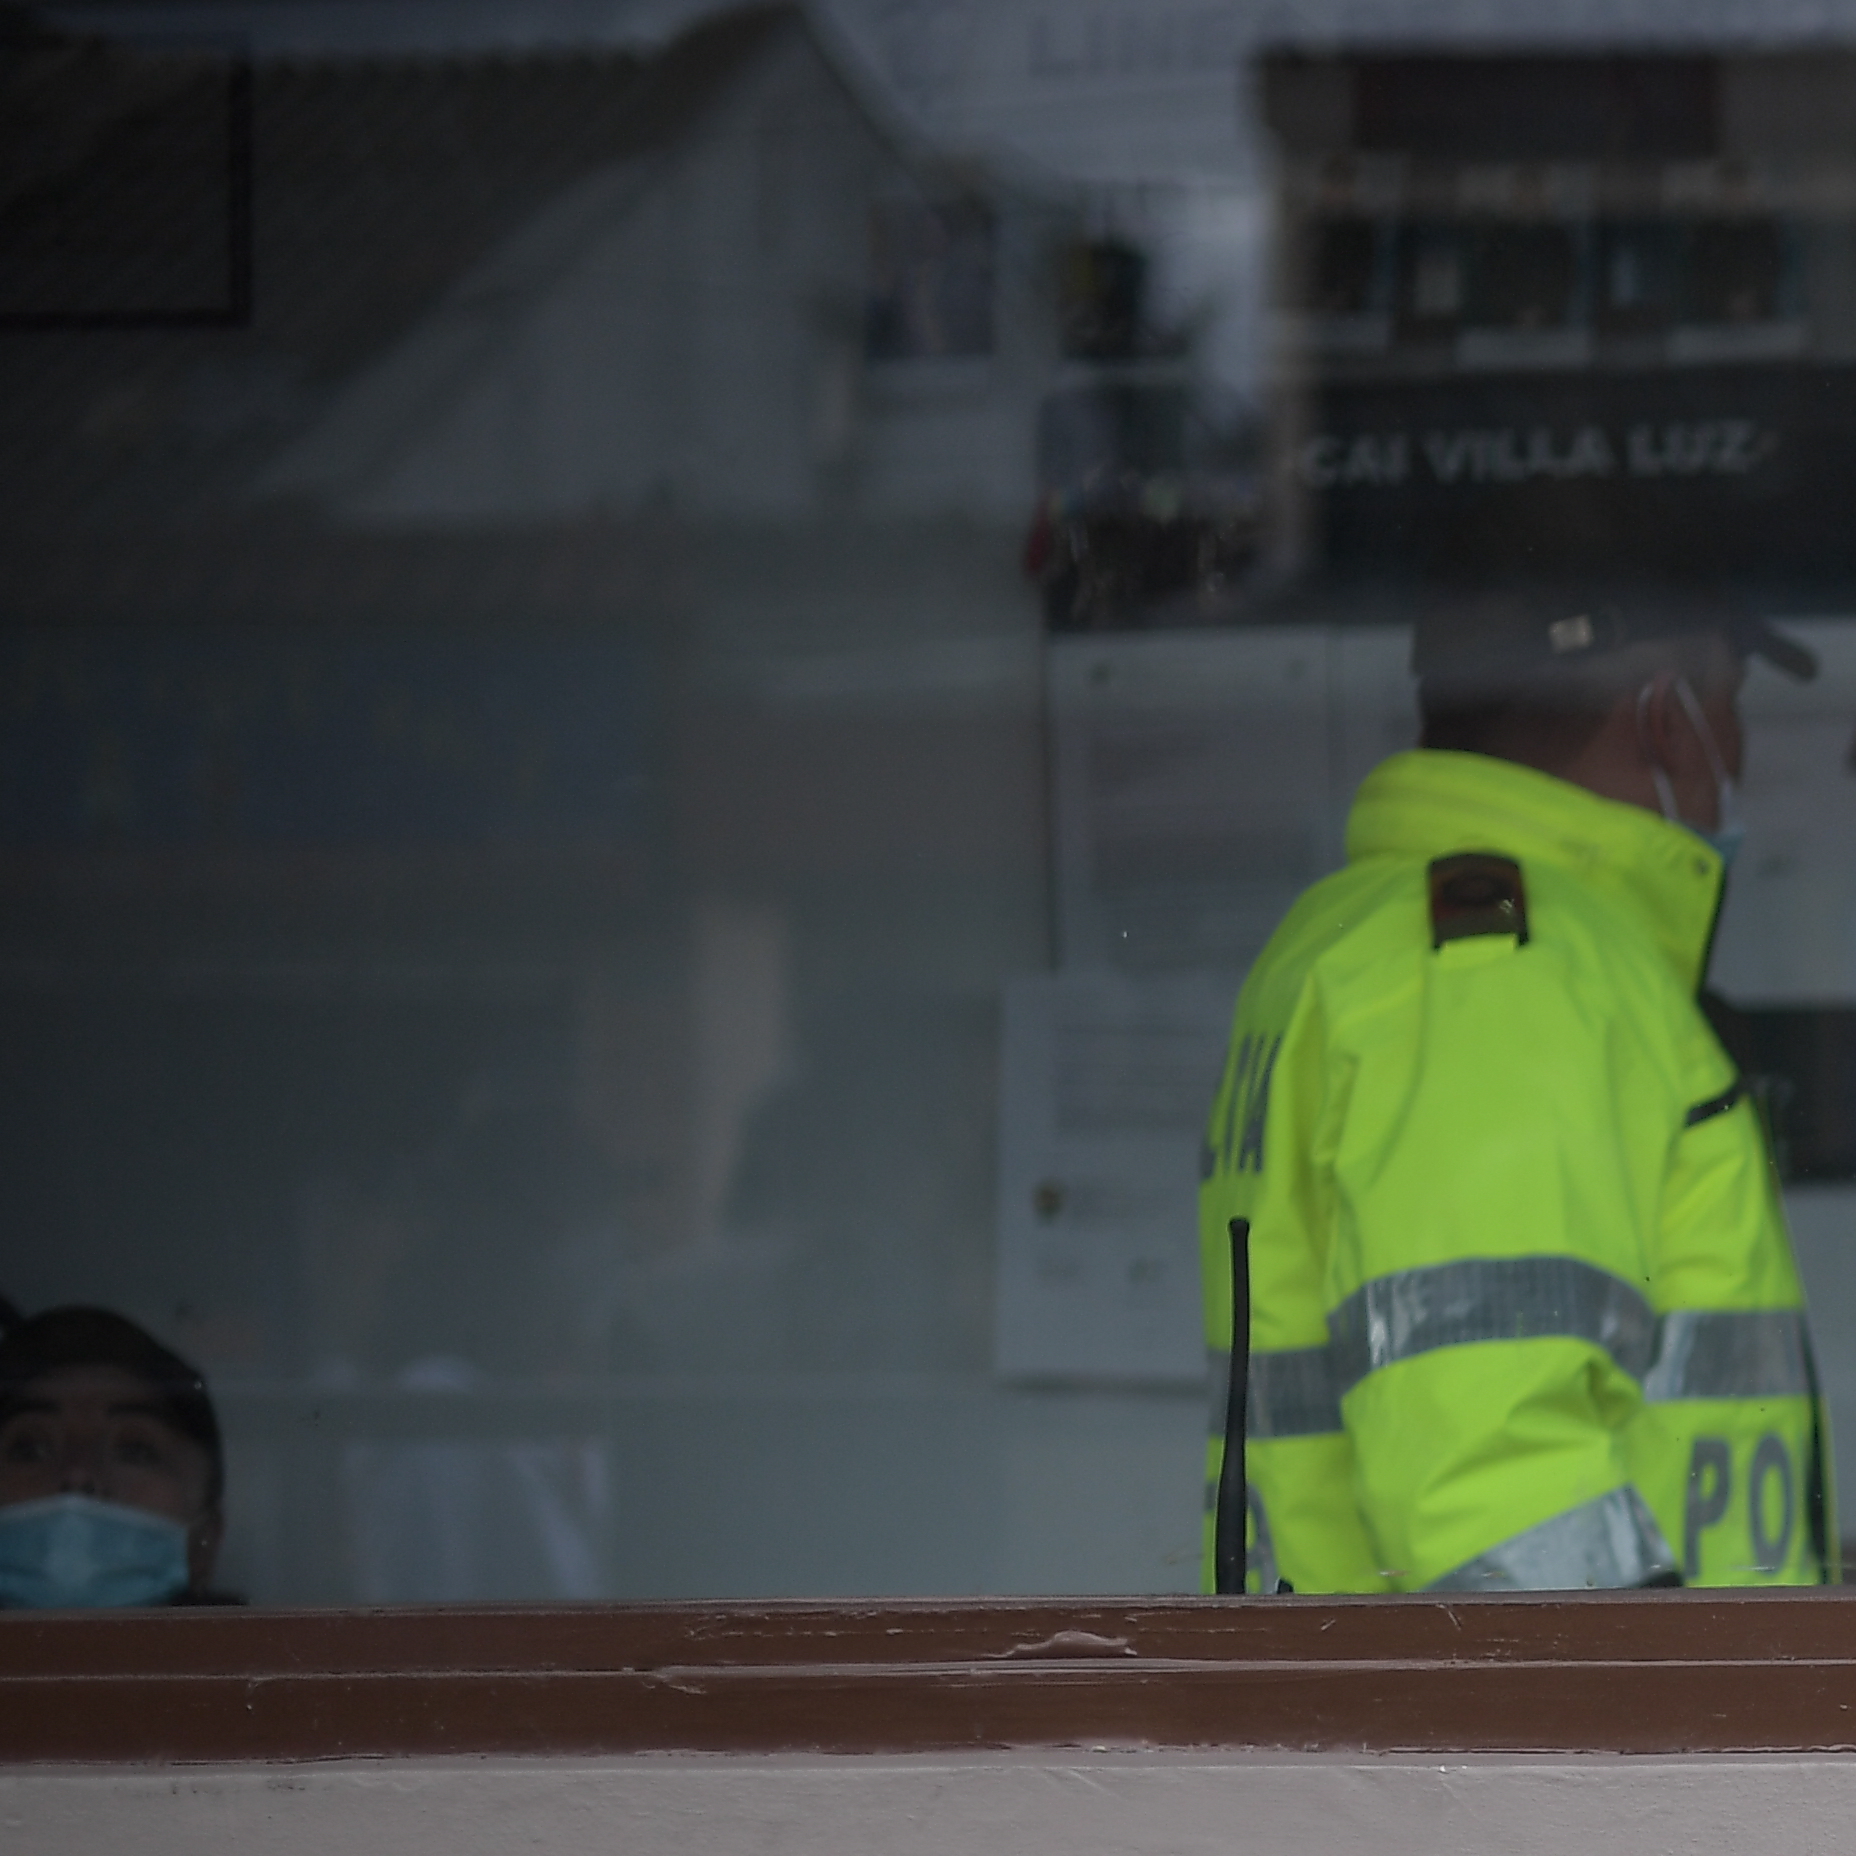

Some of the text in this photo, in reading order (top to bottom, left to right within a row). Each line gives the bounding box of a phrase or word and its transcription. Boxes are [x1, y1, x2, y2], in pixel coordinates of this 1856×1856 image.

[1296, 419, 1758, 487] CAI VILLA LUZ
